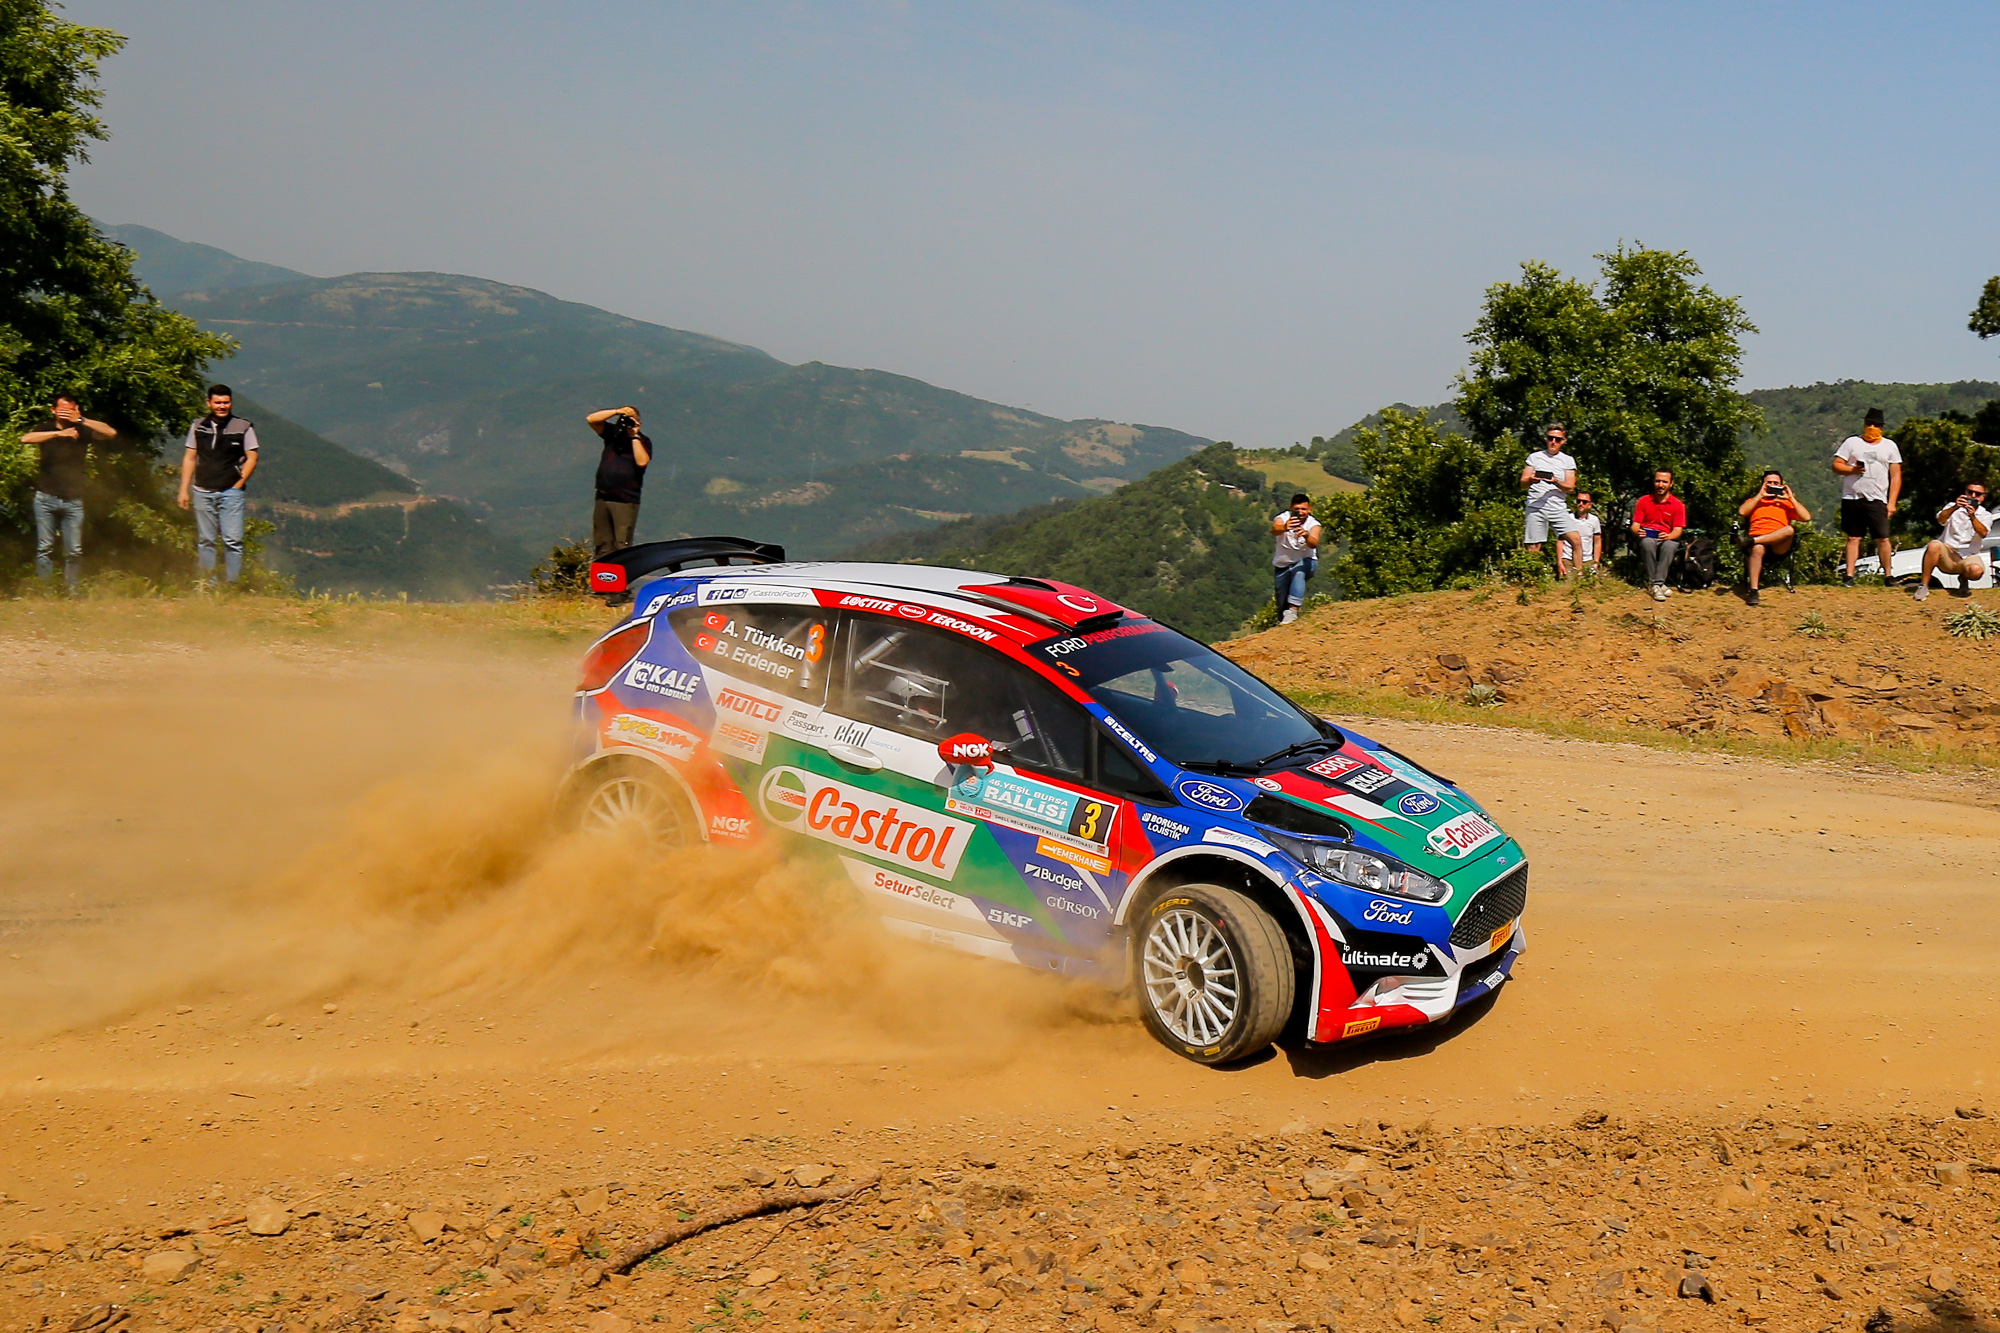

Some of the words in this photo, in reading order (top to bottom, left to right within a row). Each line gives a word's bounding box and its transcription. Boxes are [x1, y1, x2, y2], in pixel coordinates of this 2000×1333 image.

[839, 596, 898, 611] LOCTITE
[901, 605, 924, 615] Henkel
[927, 613, 997, 641] TEROSON
[722, 620, 738, 638] A.
[744, 625, 806, 660] Türkkan
[806, 624, 826, 662] 3
[1045, 637, 1088, 658] FORD
[1080, 623, 1168, 645] PERFORMANCE
[713, 640, 729, 658] B.
[731, 648, 794, 680] Erdener
[1056, 661, 1081, 677] 3
[646, 683, 659, 693] OTO
[649, 665, 701, 693] KALE
[715, 687, 784, 723] MUTLU
[787, 715, 825, 734] Passport
[834, 722, 874, 747] ekol
[952, 743, 991, 758] NGK
[1034, 791, 1068, 807] BURSA
[1191, 784, 1232, 808] Ford
[1404, 795, 1435, 813] Ford
[711, 815, 752, 833] NGK
[808, 787, 955, 870] Castrol
[995, 814, 1009, 823] SHELL
[1079, 802, 1102, 840] 3
[1150, 814, 1190, 834] BORUSAN
[1444, 814, 1495, 849] Castrol
[1050, 845, 1107, 870] YEMEKHANE
[874, 872, 956, 910] SeturSelect
[1041, 868, 1083, 892] Budget
[1046, 895, 1101, 919] GÜRSOY
[1158, 898, 1191, 911] ZERO
[1363, 899, 1414, 925] Ford
[987, 909, 1032, 928] SKF
[1342, 950, 1412, 967] ultimate
[1346, 1020, 1378, 1034] PIRELLI
